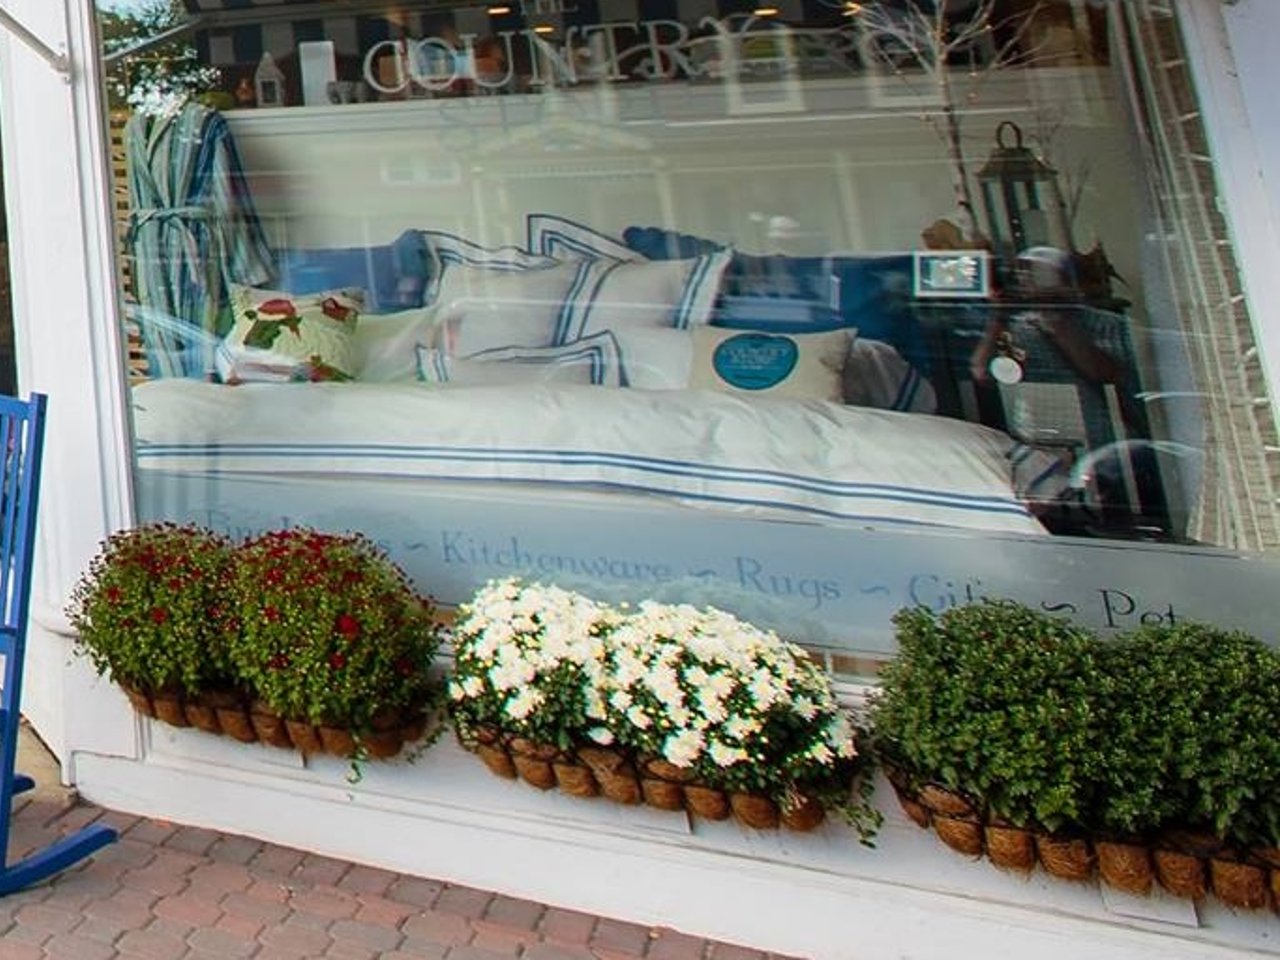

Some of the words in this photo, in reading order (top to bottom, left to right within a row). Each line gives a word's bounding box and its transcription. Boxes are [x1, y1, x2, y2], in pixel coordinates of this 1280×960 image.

[362, 14, 758, 94] COUNTRY
[441, 530, 672, 584] Kitchenware
[734, 555, 841, 608] Rugs
